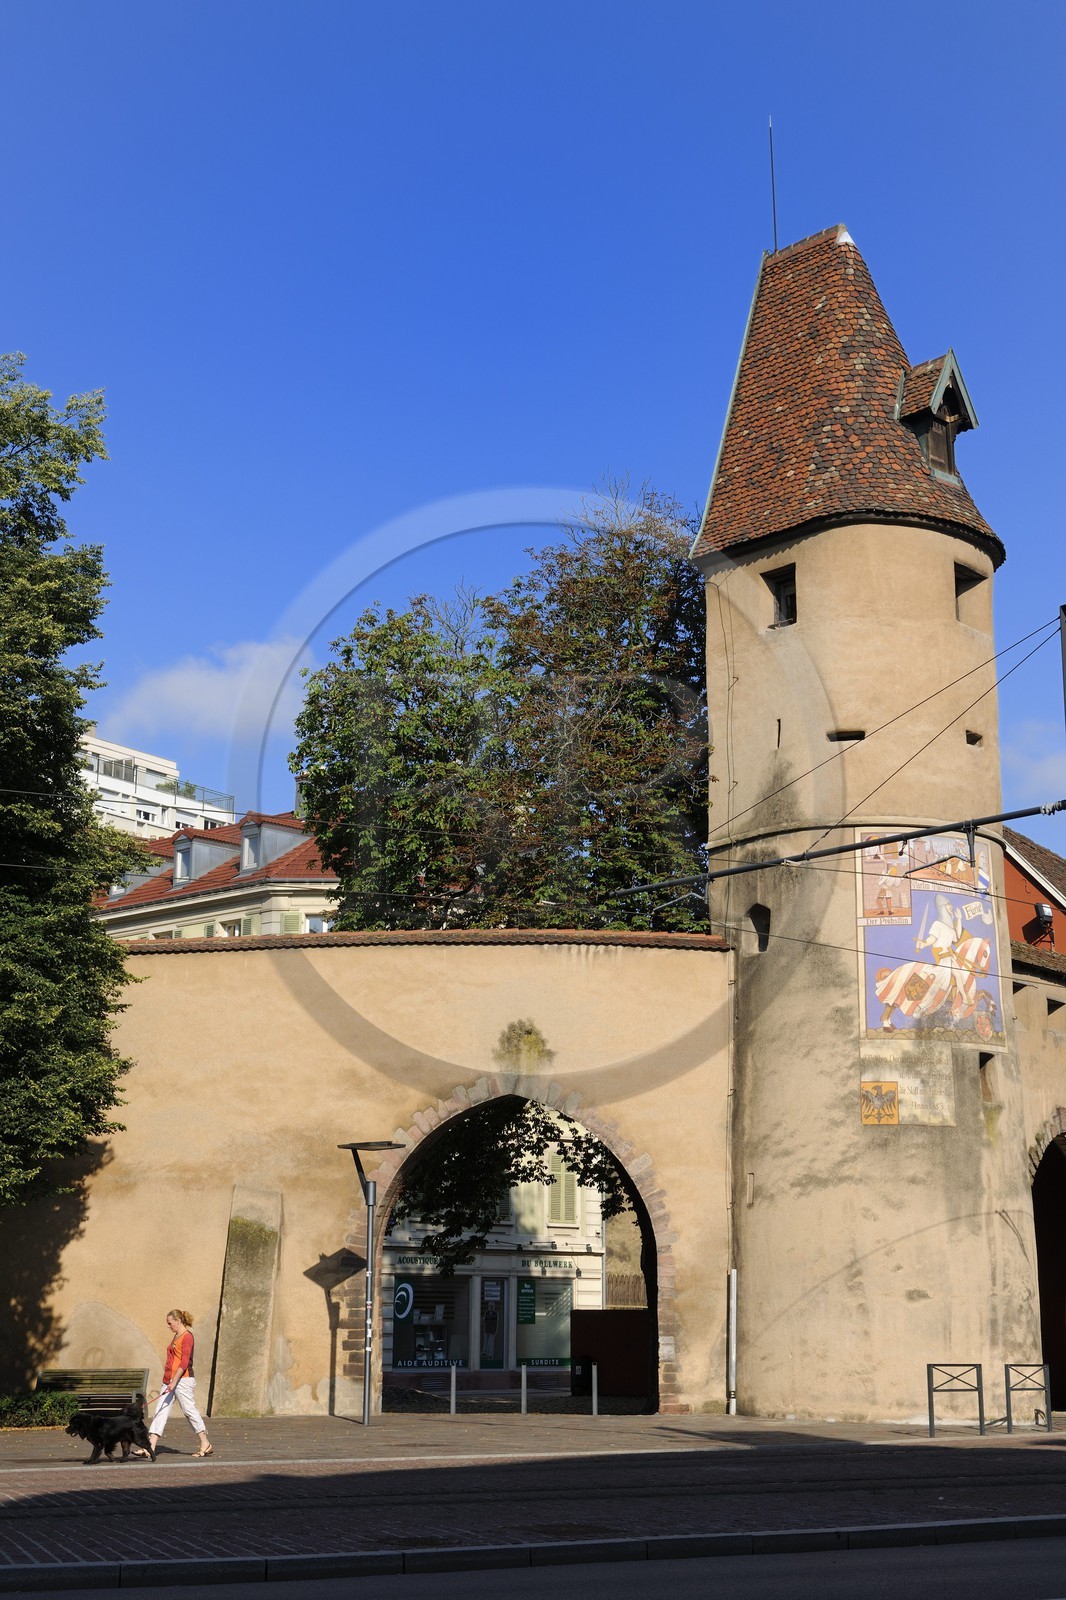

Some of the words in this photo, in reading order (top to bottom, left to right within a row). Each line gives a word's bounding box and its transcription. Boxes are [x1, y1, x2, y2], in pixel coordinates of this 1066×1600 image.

[396, 1256, 439, 1265] ACOUSTIQUE
[521, 1259, 532, 1267] DU
[534, 1260, 573, 1269] BOLLWERK
[397, 1359, 418, 1367] AIDE
[421, 1359, 463, 1367] AUDITIVE
